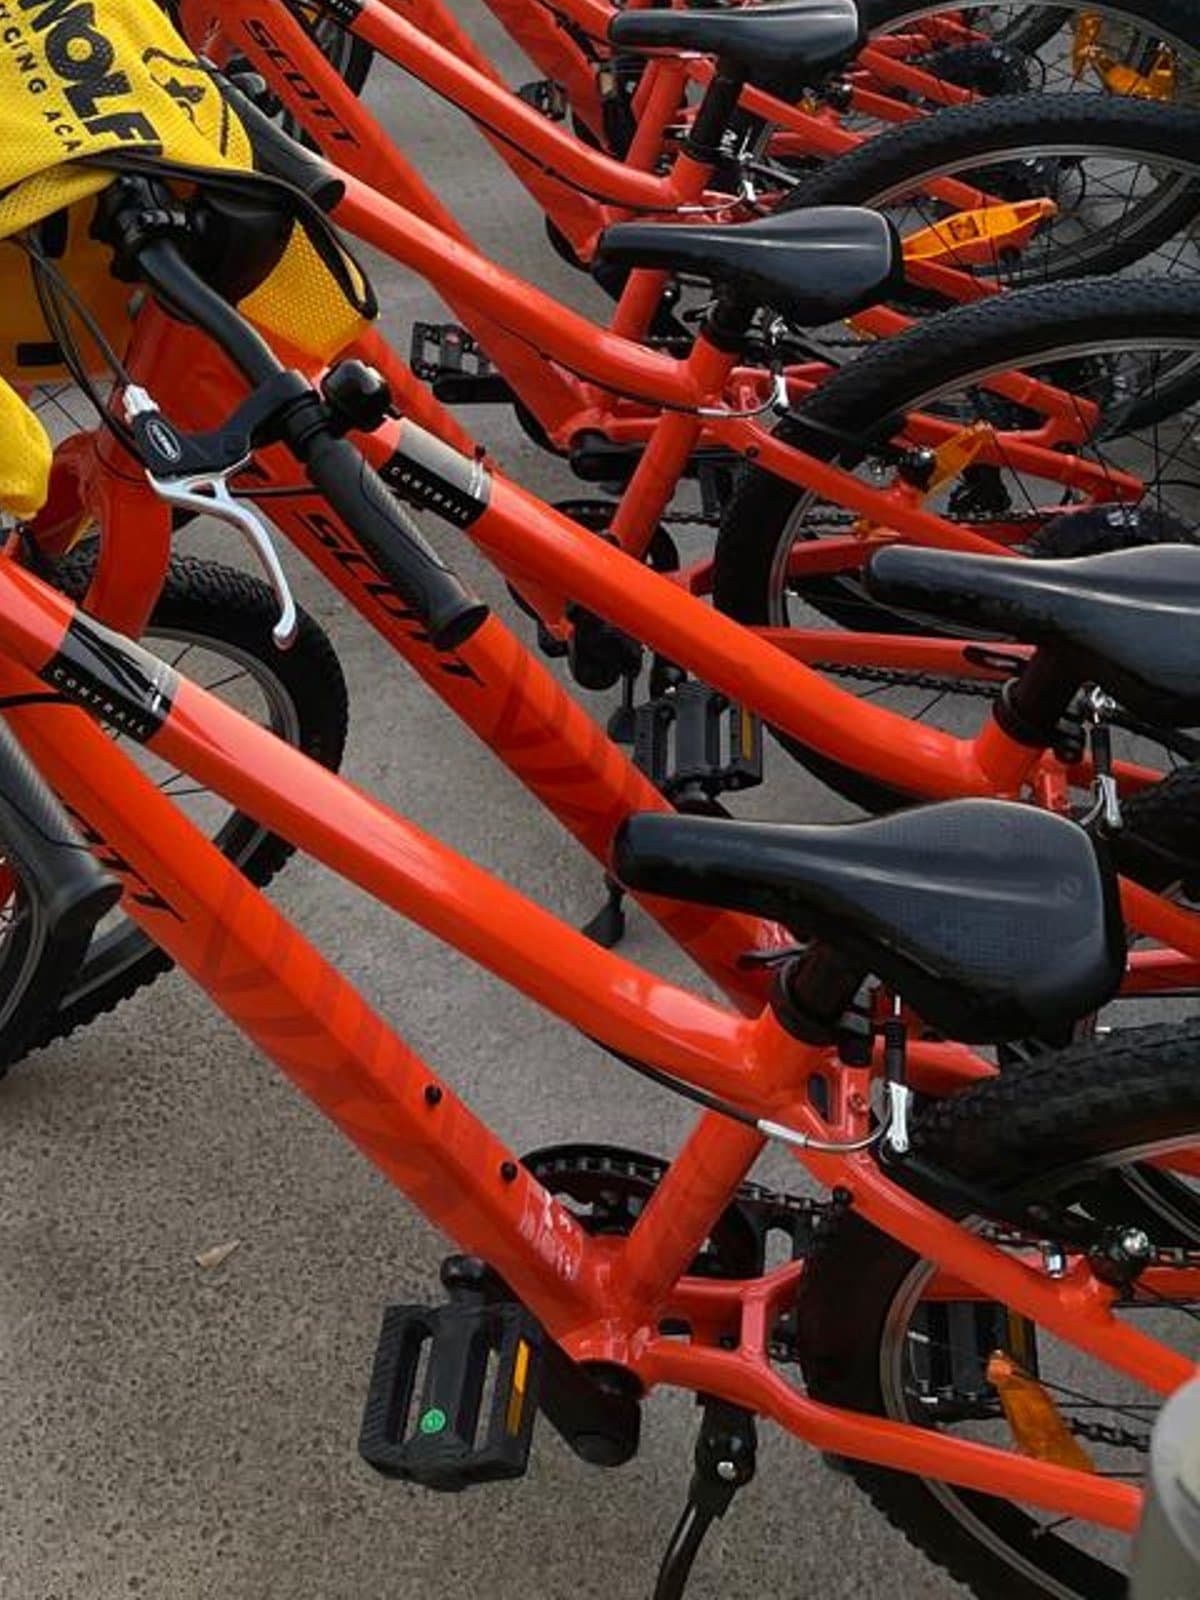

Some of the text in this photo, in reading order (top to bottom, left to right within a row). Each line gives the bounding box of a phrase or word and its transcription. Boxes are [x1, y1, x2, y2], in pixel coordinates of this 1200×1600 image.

[241, 19, 361, 148] SCOTT
[43, 111, 83, 151] ACA
[53, 668, 146, 735] CONTRAIL
